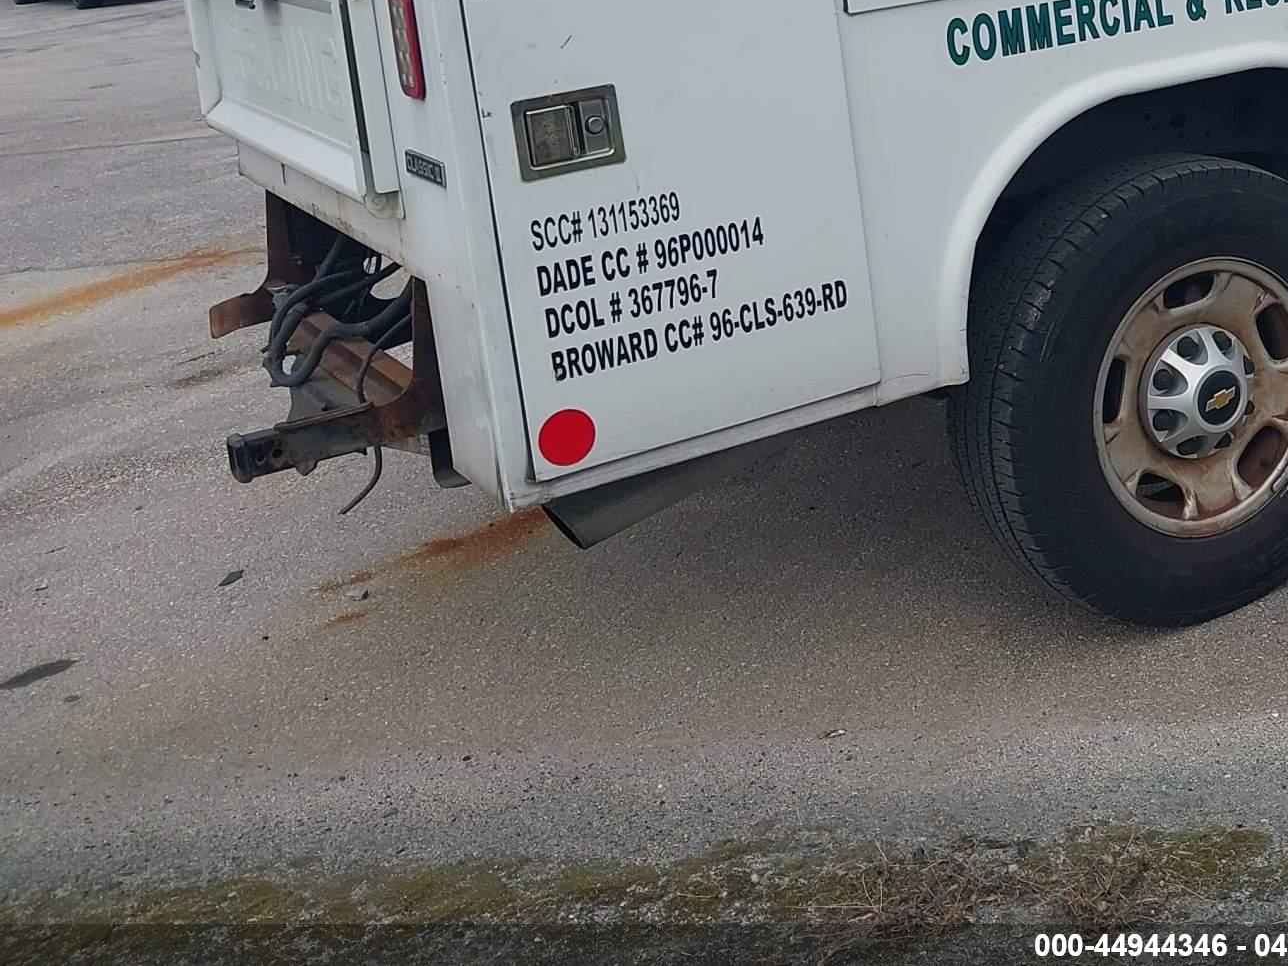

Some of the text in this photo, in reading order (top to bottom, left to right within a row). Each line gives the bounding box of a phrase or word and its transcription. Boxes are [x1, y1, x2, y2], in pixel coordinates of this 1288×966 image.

[530, 191, 680, 251] SCC# 131153369
[536, 216, 764, 296] DADE CC # 96P000014
[545, 269, 718, 338] DCOL # 367796-7
[551, 280, 848, 381] BROWARD CC# 96-CLS-639-RD
